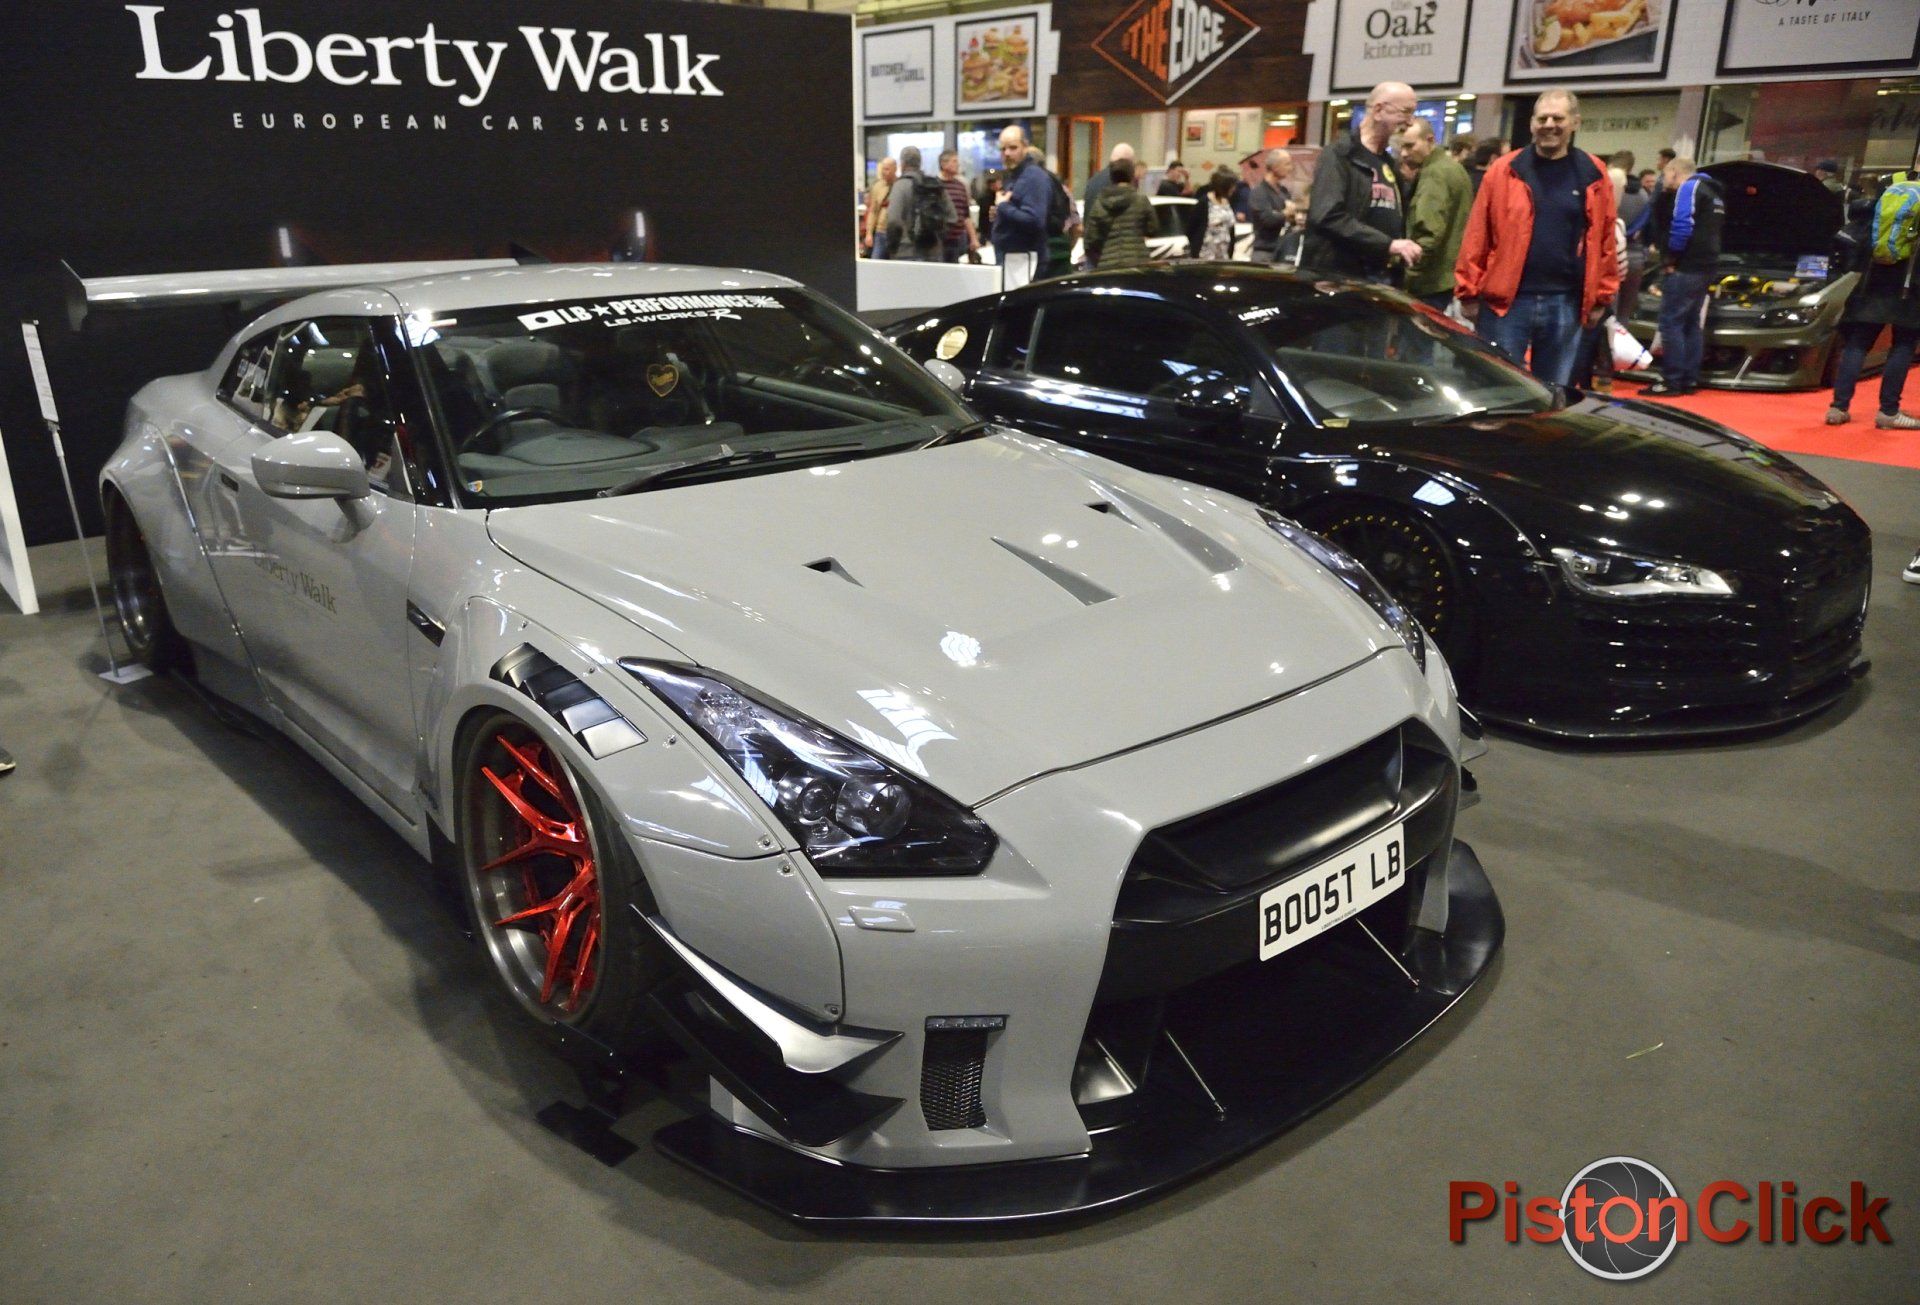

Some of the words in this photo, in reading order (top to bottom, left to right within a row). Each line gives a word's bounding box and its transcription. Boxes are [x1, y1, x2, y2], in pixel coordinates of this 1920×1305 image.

[1365, 6, 1435, 39] Oak
[1790, 15, 1819, 26] TASTE
[1823, 13, 1837, 24] OF
[1841, 11, 1872, 22] ITALY
[124, 4, 508, 107] Liberty
[517, 25, 725, 97] Walk
[1128, 0, 1172, 81] THE
[1168, 0, 1226, 83] EDGE
[1363, 41, 1433, 60] kitchen
[232, 112, 447, 131] EUROPEAN
[481, 114, 544, 131] CAR
[574, 116, 671, 133] SALES
[556, 304, 593, 323] LB
[608, 294, 754, 317] PERFORMANCE
[300, 571, 337, 615] Walk
[1371, 840, 1401, 890] LB
